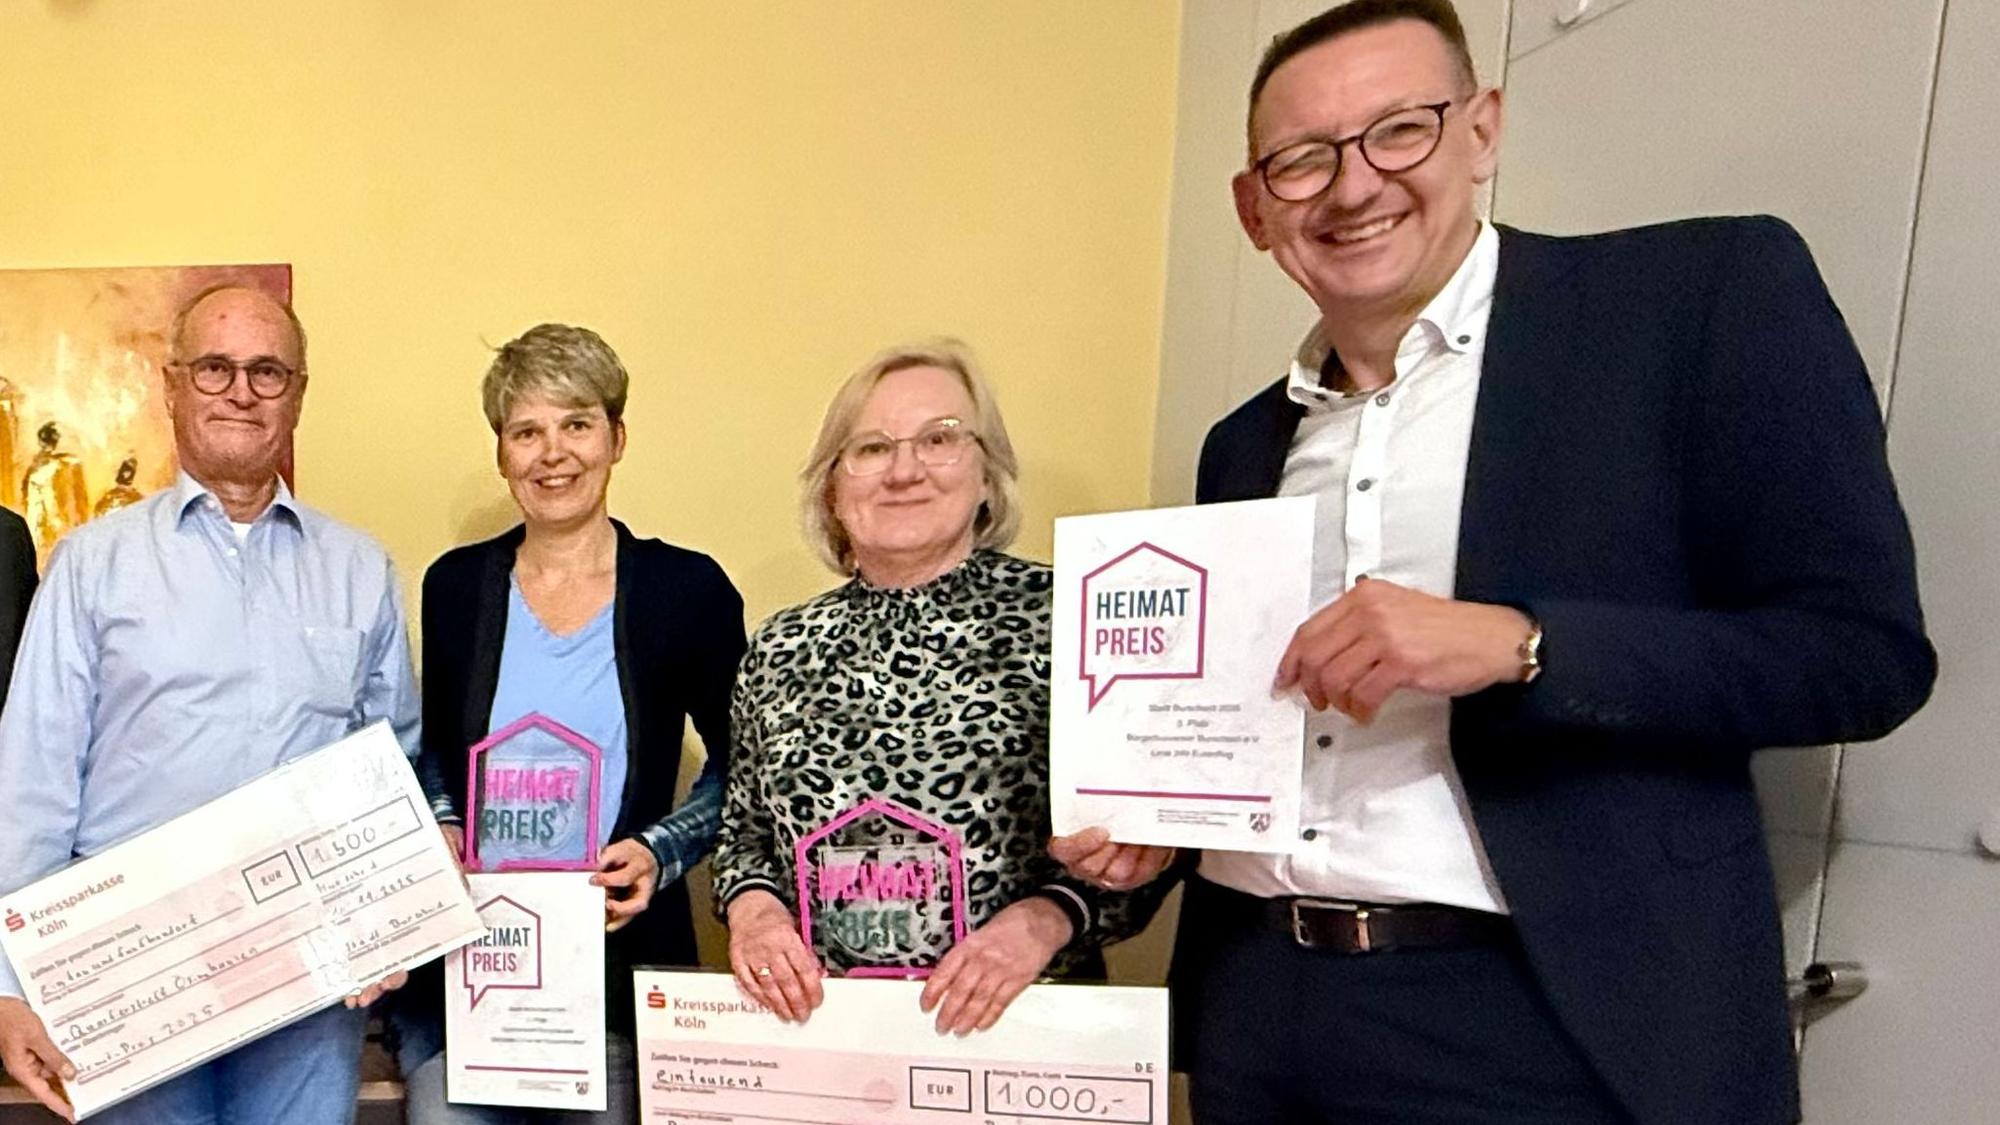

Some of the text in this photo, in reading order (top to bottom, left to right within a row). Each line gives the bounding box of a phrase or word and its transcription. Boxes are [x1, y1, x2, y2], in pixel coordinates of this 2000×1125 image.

[1096, 587, 1190, 620] HEIMAT
[1095, 626, 1165, 656] PREIS
[482, 808, 556, 841] PREIS
[259, 868, 283, 887] EUR
[30, 874, 125, 922] Kreissparkasse
[37, 919, 68, 938] Köln
[473, 952, 517, 972] PREIS
[673, 998, 774, 1014] Kreissparkass
[162, 1004, 214, 1036] 2025
[674, 1015, 706, 1030] Köln
[927, 1083, 954, 1095] EUR
